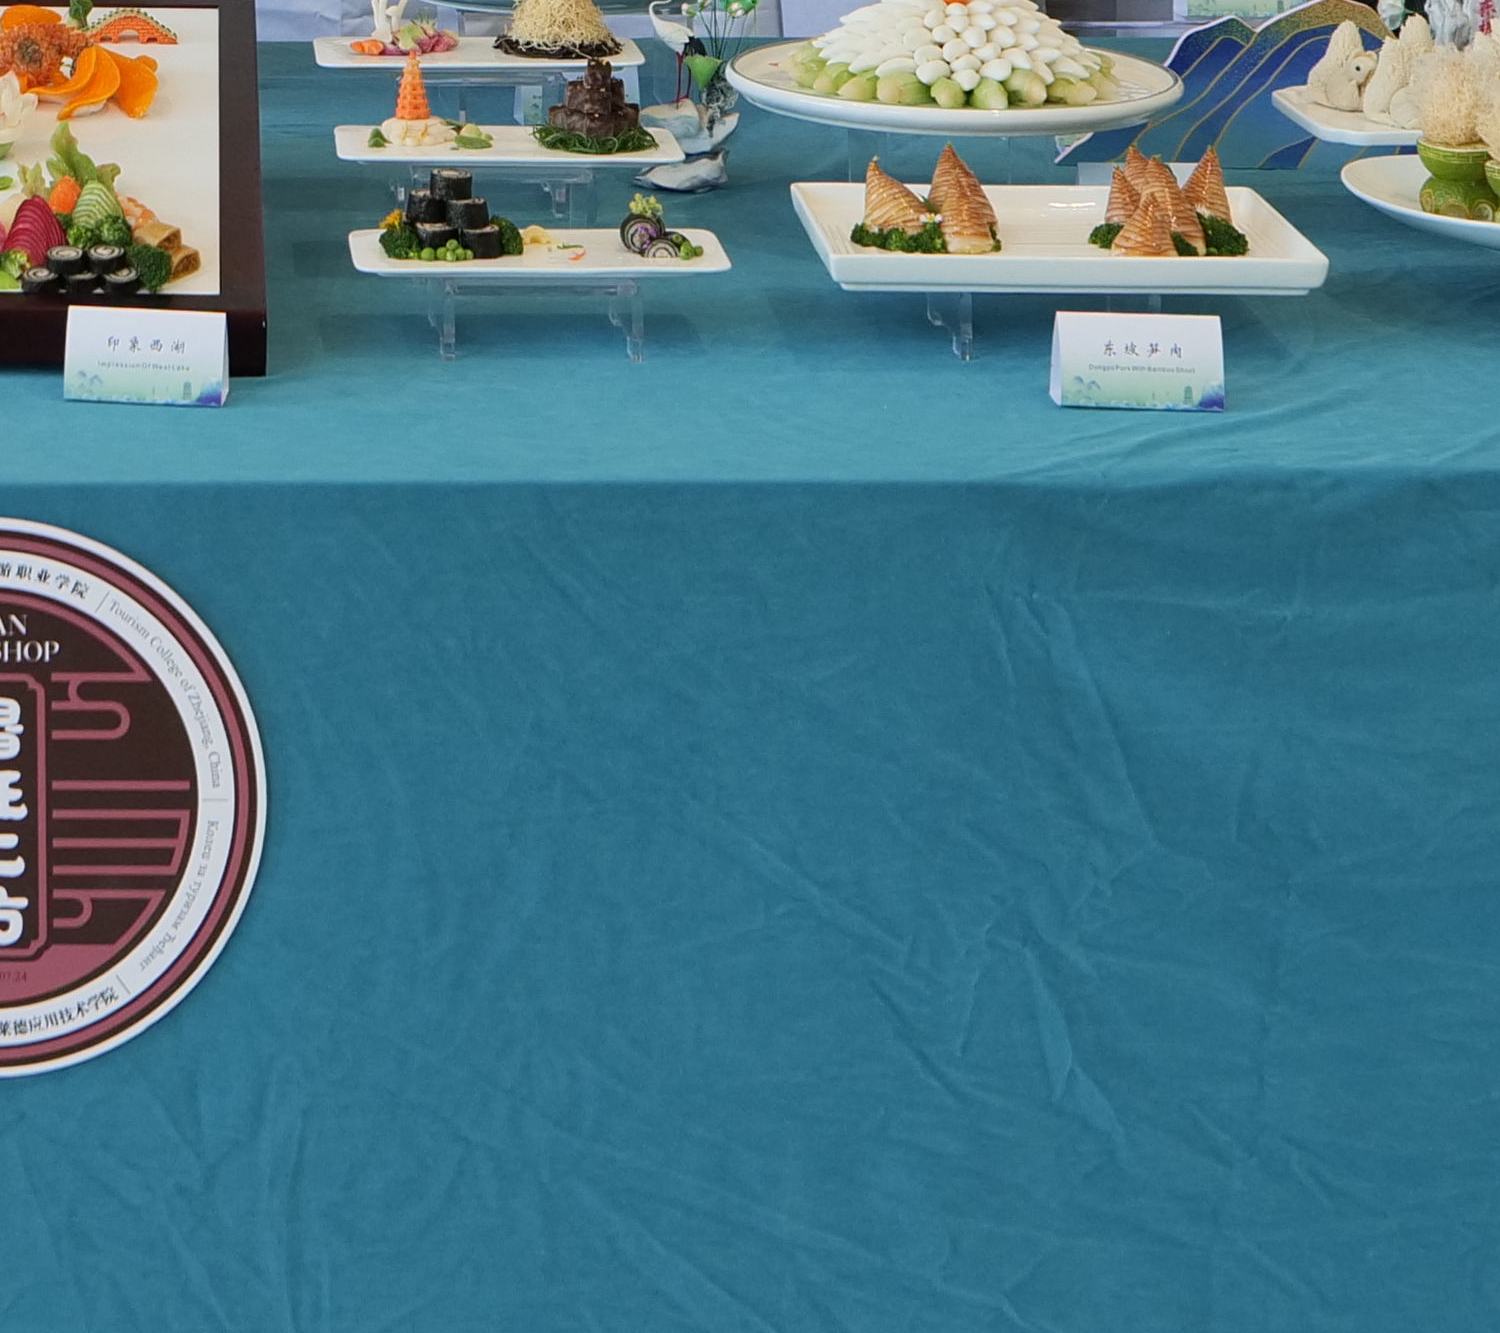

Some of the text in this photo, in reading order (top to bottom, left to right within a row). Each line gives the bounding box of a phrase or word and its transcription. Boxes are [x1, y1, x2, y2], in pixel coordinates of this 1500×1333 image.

[107, 335, 185, 354] 印象西湖
[104, 596, 154, 640] Tourism
[145, 632, 187, 679] College
[175, 673, 196, 694] of
[205, 748, 225, 789] China
